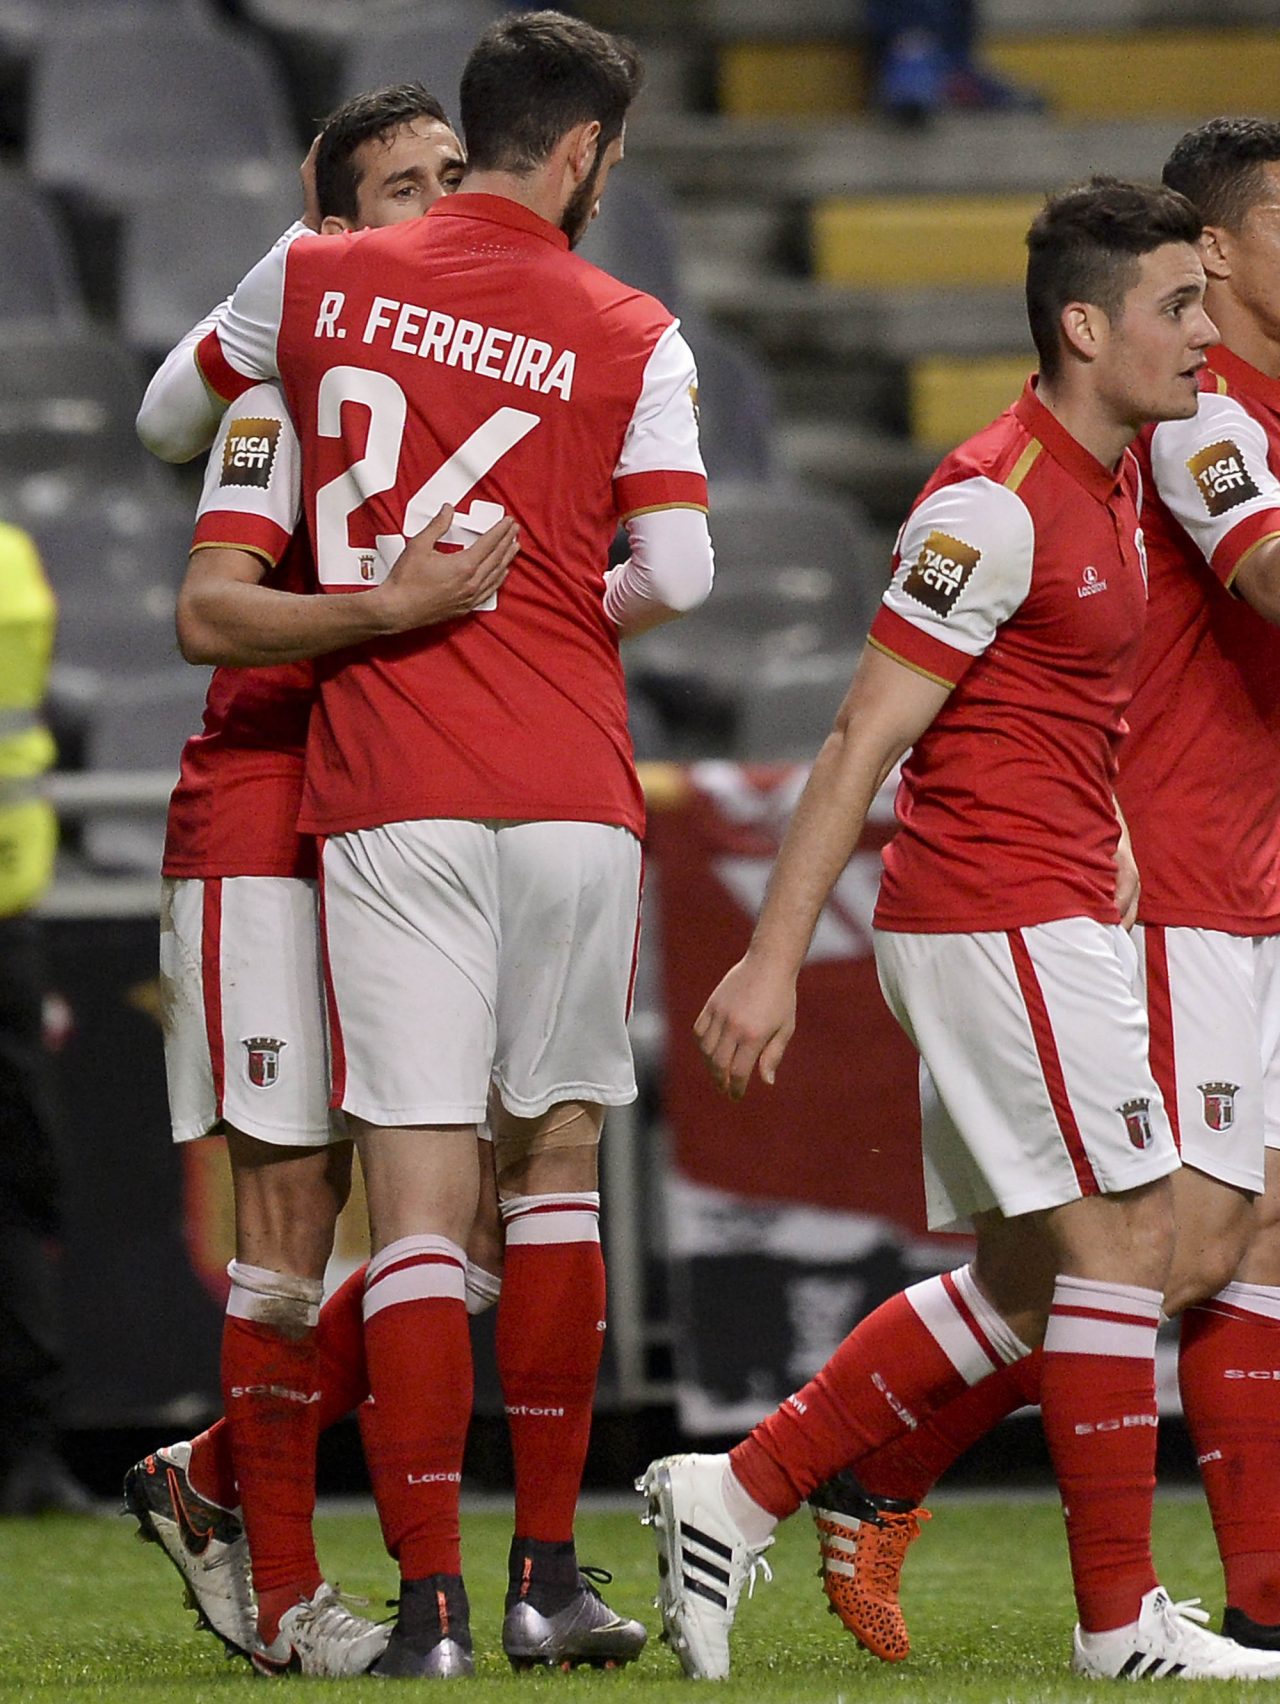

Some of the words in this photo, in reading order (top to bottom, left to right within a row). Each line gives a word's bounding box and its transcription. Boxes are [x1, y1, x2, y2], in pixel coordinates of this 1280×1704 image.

[314, 291, 347, 339] R.
[362, 296, 577, 402] FERREIRA
[233, 451, 269, 469] CTT
[1213, 472, 1246, 494] CTT
[922, 567, 959, 597] CTT
